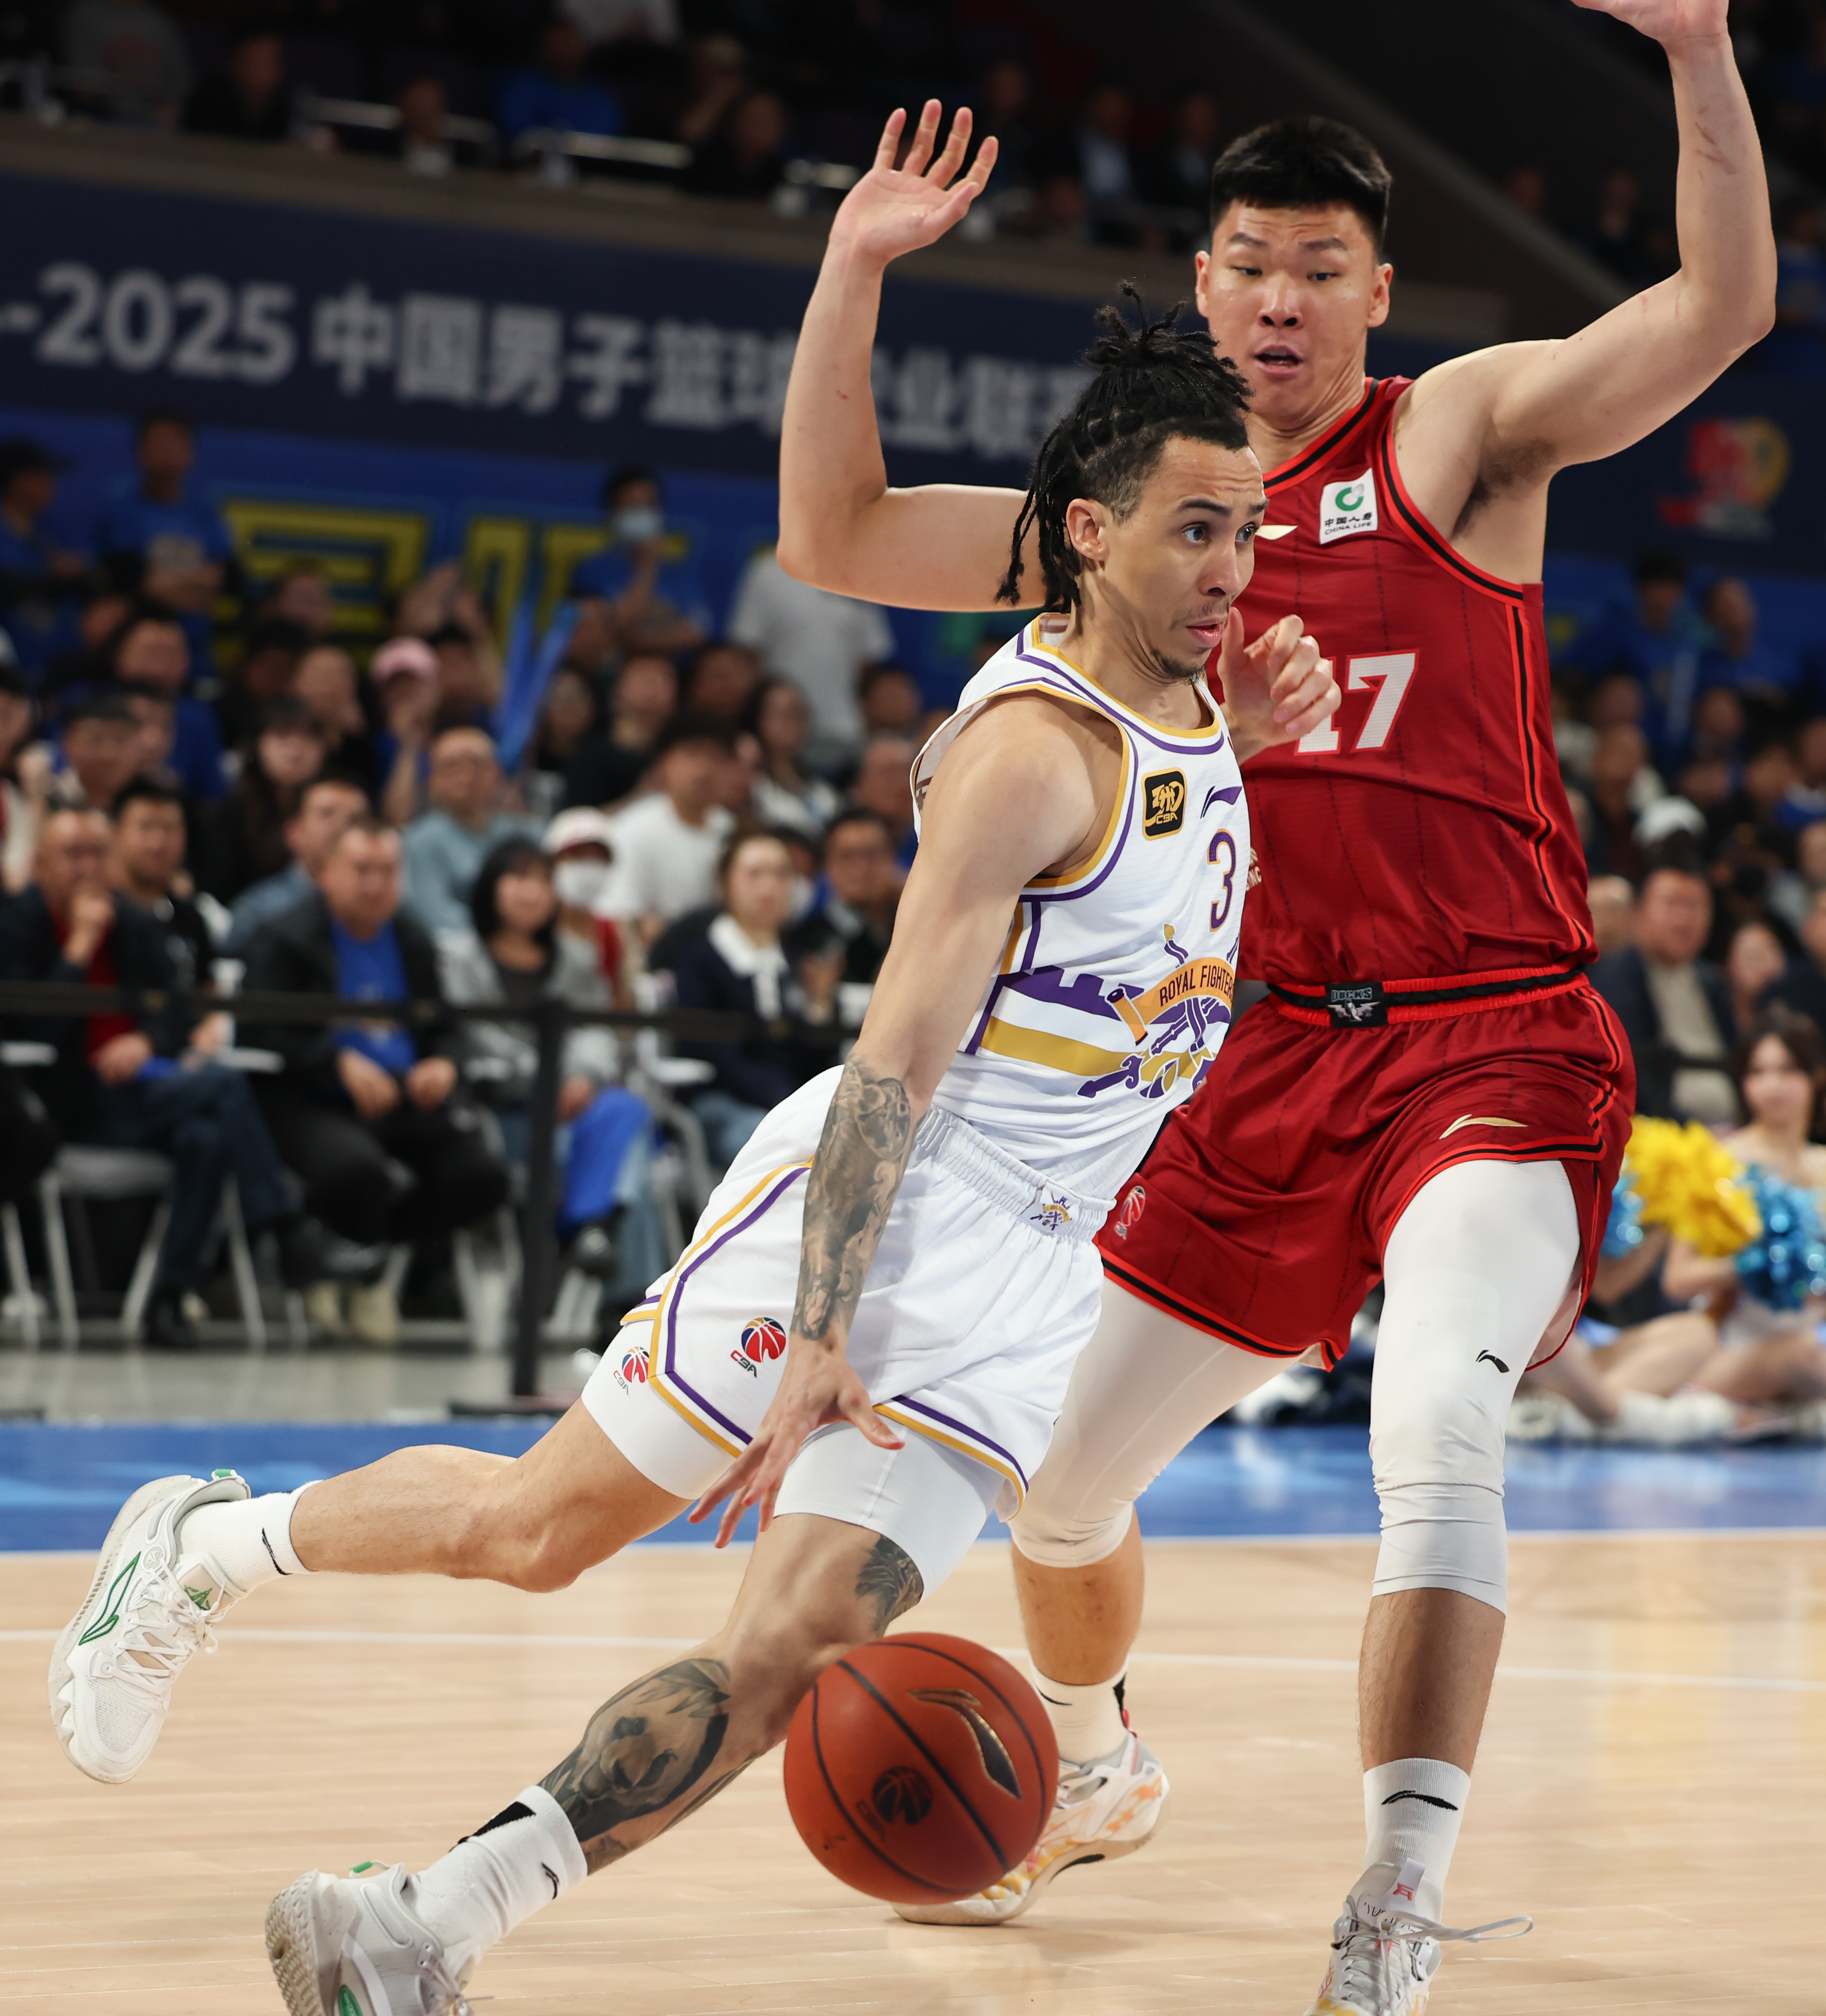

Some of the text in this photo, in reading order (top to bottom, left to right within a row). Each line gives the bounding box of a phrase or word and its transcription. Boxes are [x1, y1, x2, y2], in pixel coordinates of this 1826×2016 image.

[1325, 525, 1350, 535] CHINA
[1156, 811, 1178, 825] CBA
[1207, 828, 1236, 932] 3
[1159, 968, 1196, 1007] ROYAL
[1331, 987, 1372, 1002] DUCKS
[730, 1350, 758, 1378] CBA
[613, 1370, 629, 1396] CBA
